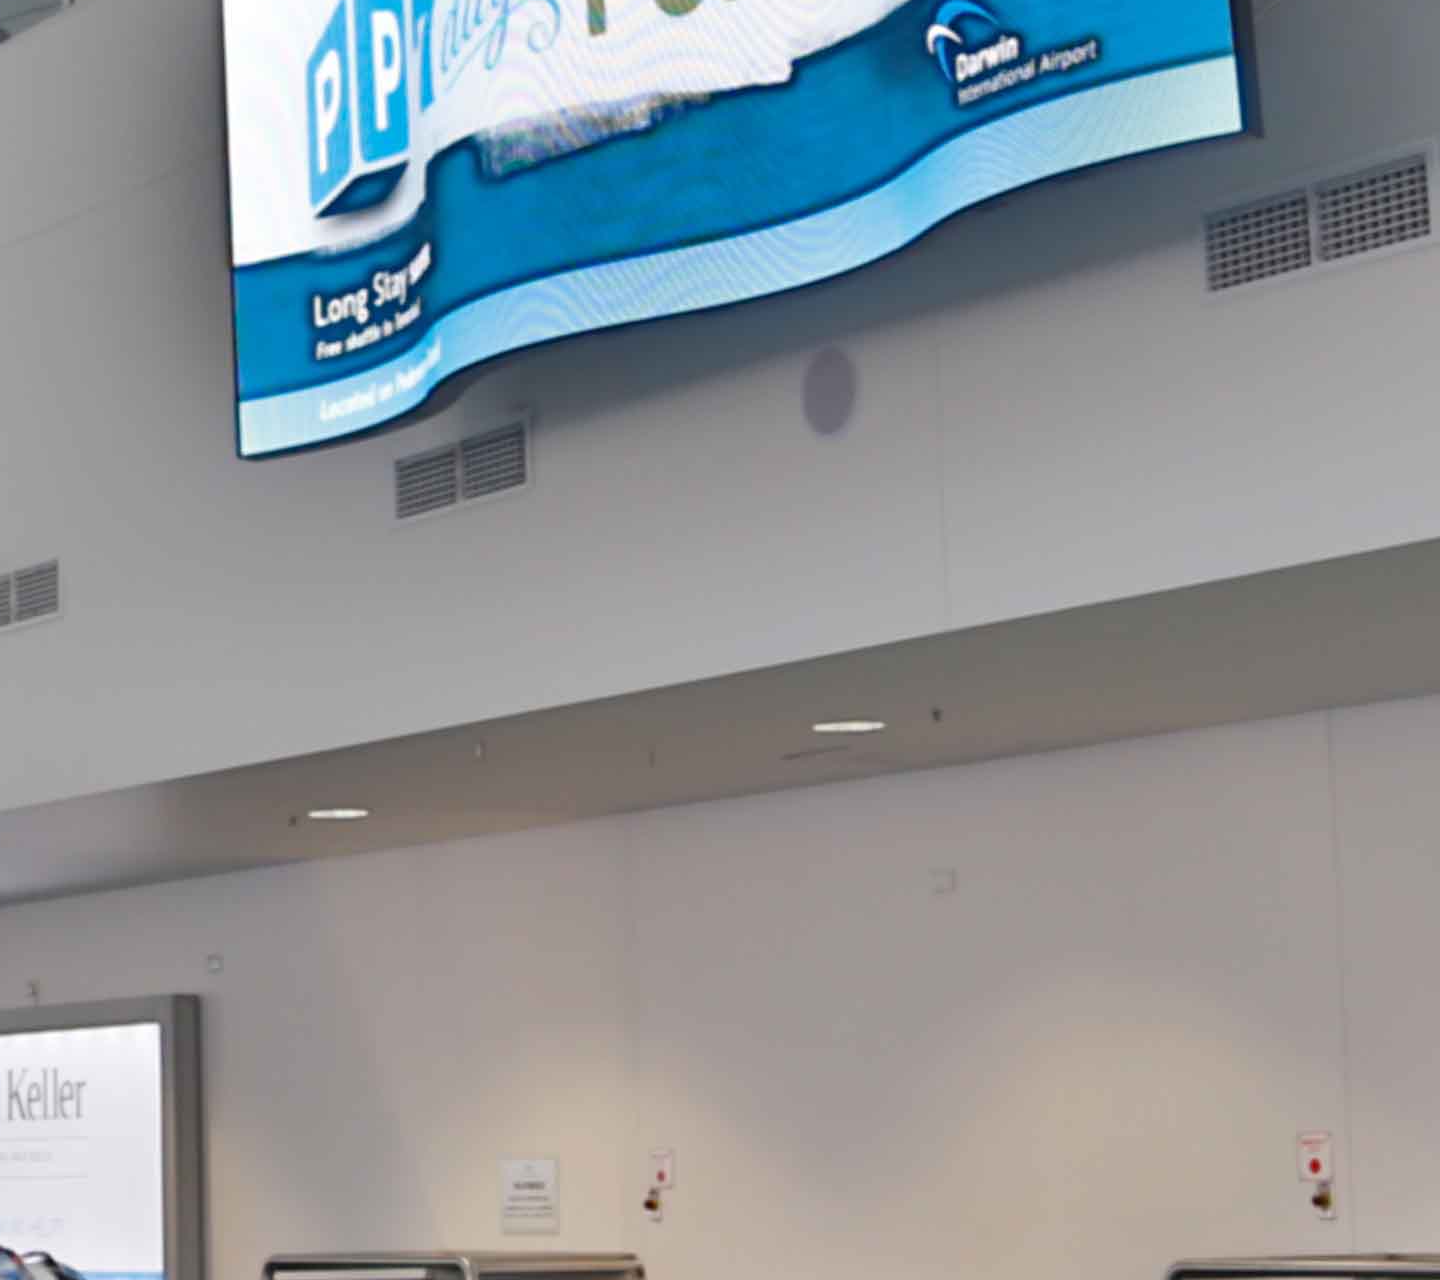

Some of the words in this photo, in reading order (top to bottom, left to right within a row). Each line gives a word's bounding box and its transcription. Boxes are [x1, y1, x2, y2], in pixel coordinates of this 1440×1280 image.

[954, 35, 1020, 84] Darwin
[957, 58, 1036, 106] International
[1039, 39, 1098, 75] Airport
[312, 286, 370, 328] Long
[372, 270, 408, 307] Stay
[7, 1066, 87, 1122] Keller
